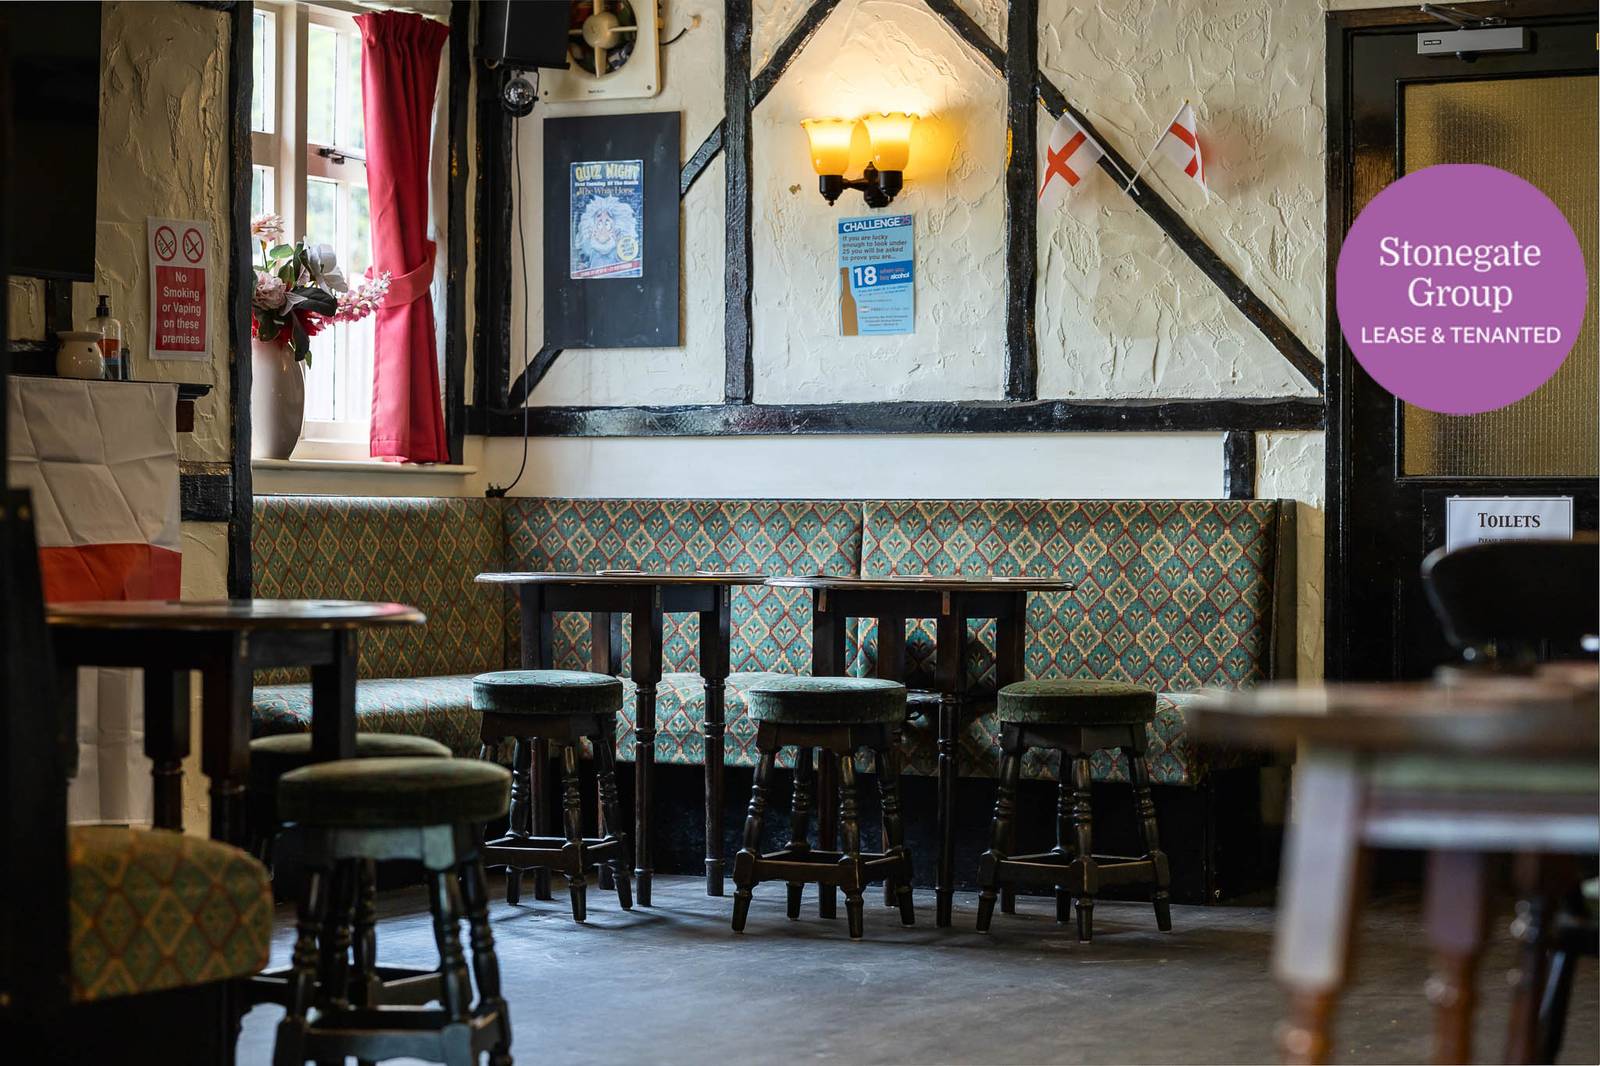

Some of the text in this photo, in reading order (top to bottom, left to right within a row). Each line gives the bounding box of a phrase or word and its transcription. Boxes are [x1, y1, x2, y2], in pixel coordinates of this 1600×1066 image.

[575, 163, 640, 182] QUIZ NIGHT
[175, 271, 187, 282] No
[854, 266, 877, 286] 18
[890, 272, 910, 280] alcohol
[163, 286, 200, 301] Smoking
[162, 302, 201, 316] or Vaping
[163, 317, 199, 329] on these
[162, 333, 200, 345] premises
[1477, 512, 1541, 528] TOILETS
